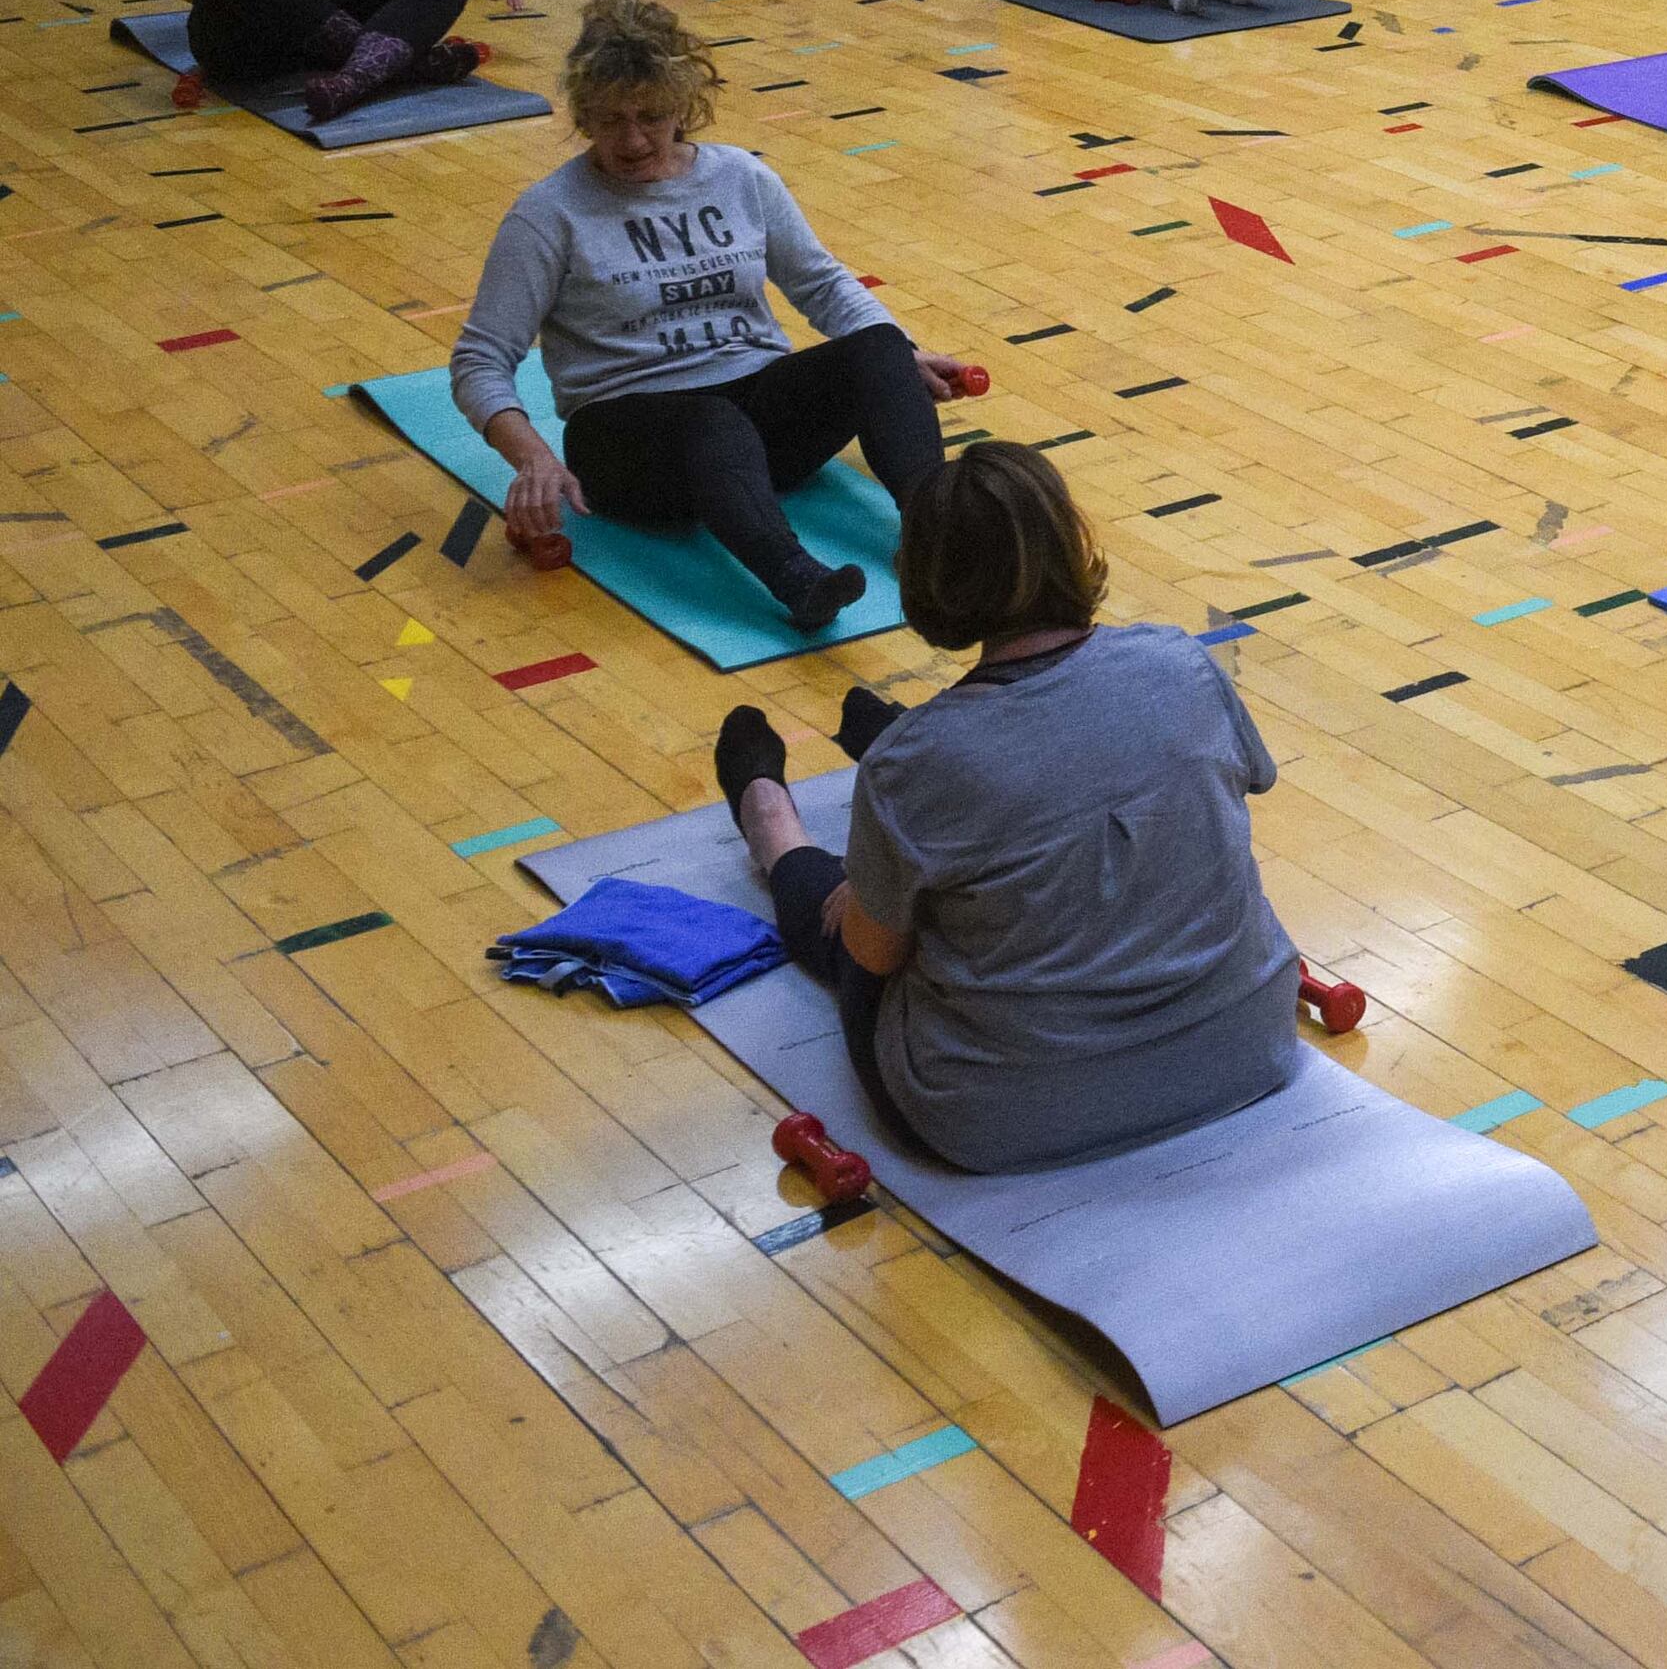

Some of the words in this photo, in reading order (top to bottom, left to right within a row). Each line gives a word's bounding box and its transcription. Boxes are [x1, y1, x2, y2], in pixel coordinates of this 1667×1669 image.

[623, 204, 735, 264] NYC
[612, 266, 642, 286] NEW
[646, 267, 678, 283] YORK
[682, 263, 697, 277] IS
[664, 275, 733, 303] STAY
